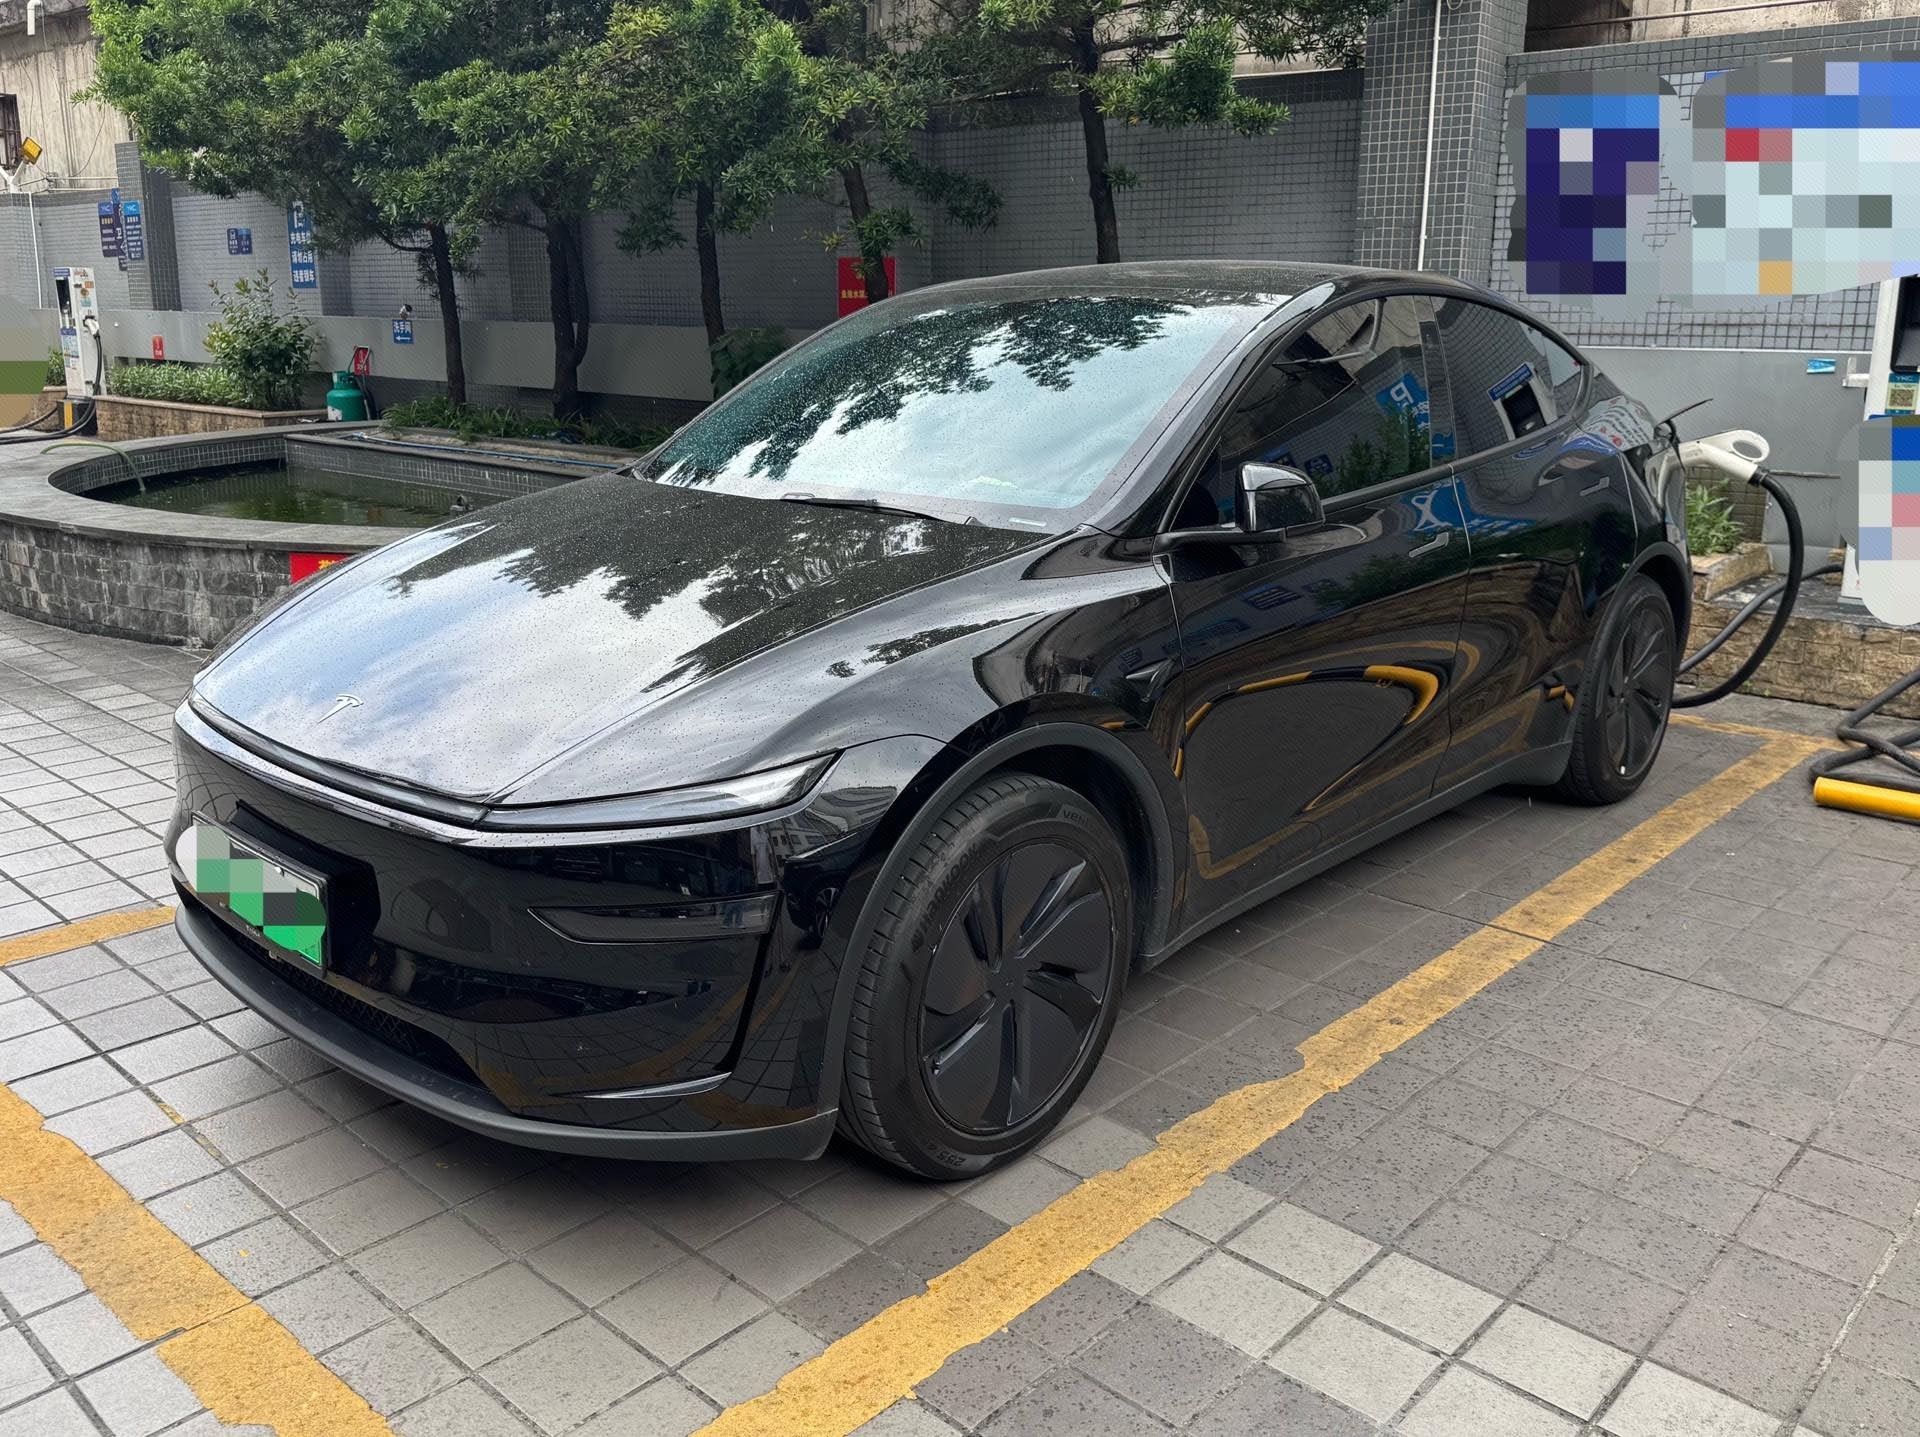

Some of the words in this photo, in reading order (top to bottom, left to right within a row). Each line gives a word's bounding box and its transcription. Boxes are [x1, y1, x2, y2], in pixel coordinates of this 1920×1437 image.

[291, 250, 314, 264] 请勿占用
[393, 320, 412, 334] 洗手间
